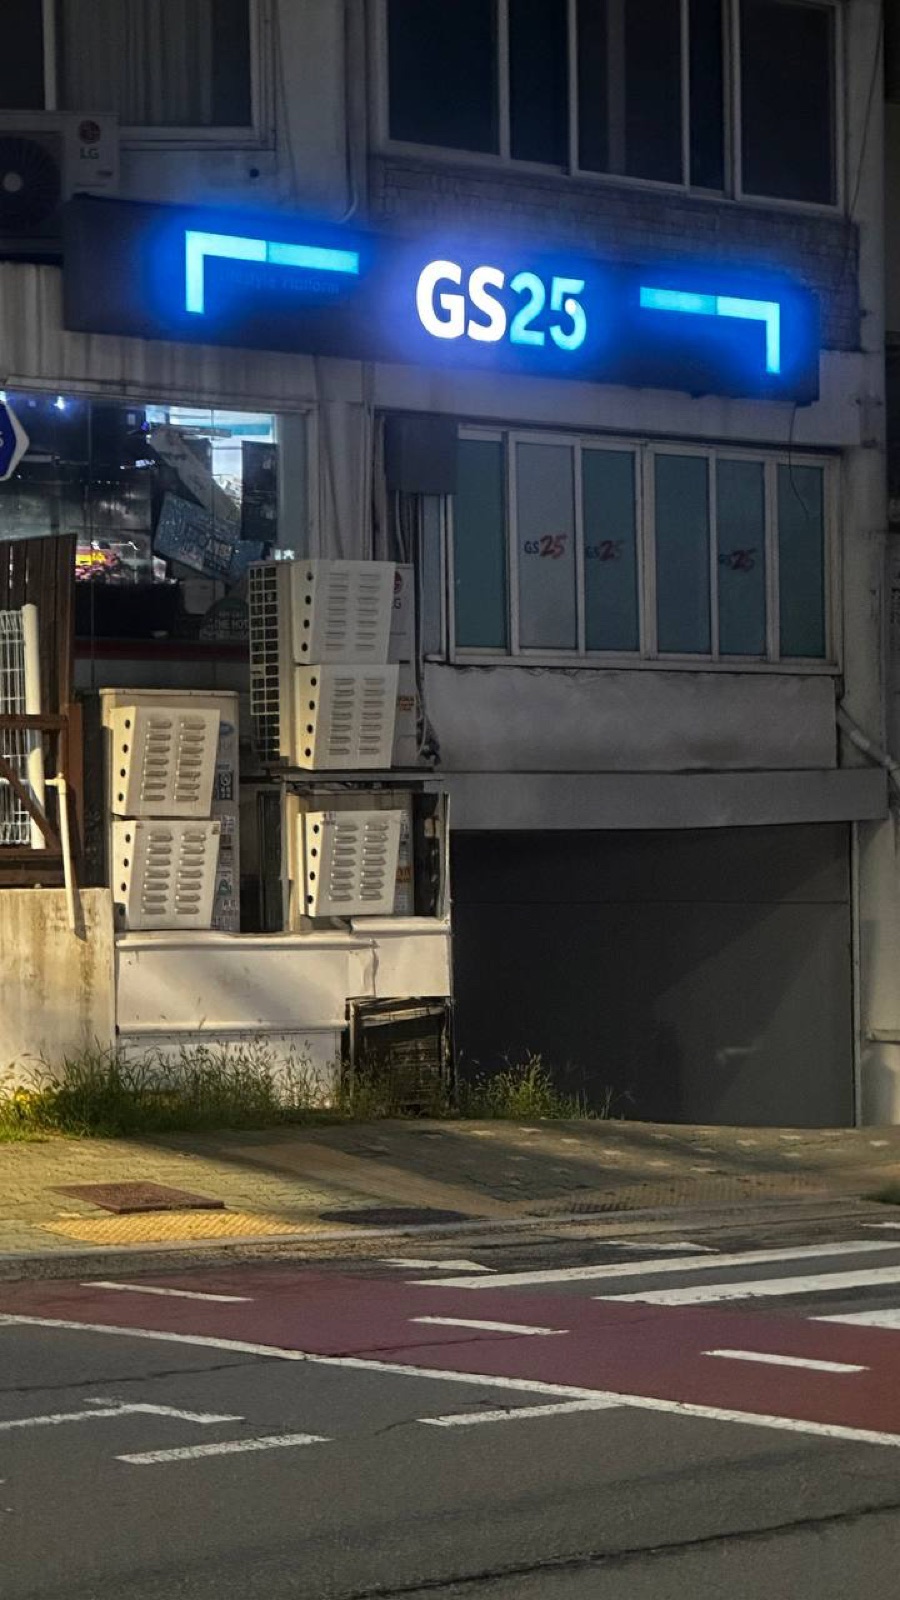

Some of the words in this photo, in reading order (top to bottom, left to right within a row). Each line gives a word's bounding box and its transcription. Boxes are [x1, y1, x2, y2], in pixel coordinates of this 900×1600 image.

[79, 148, 99, 160] LG
[416, 260, 587, 350] GS25
[523, 533, 567, 559] GS25
[584, 540, 625, 561] GS25
